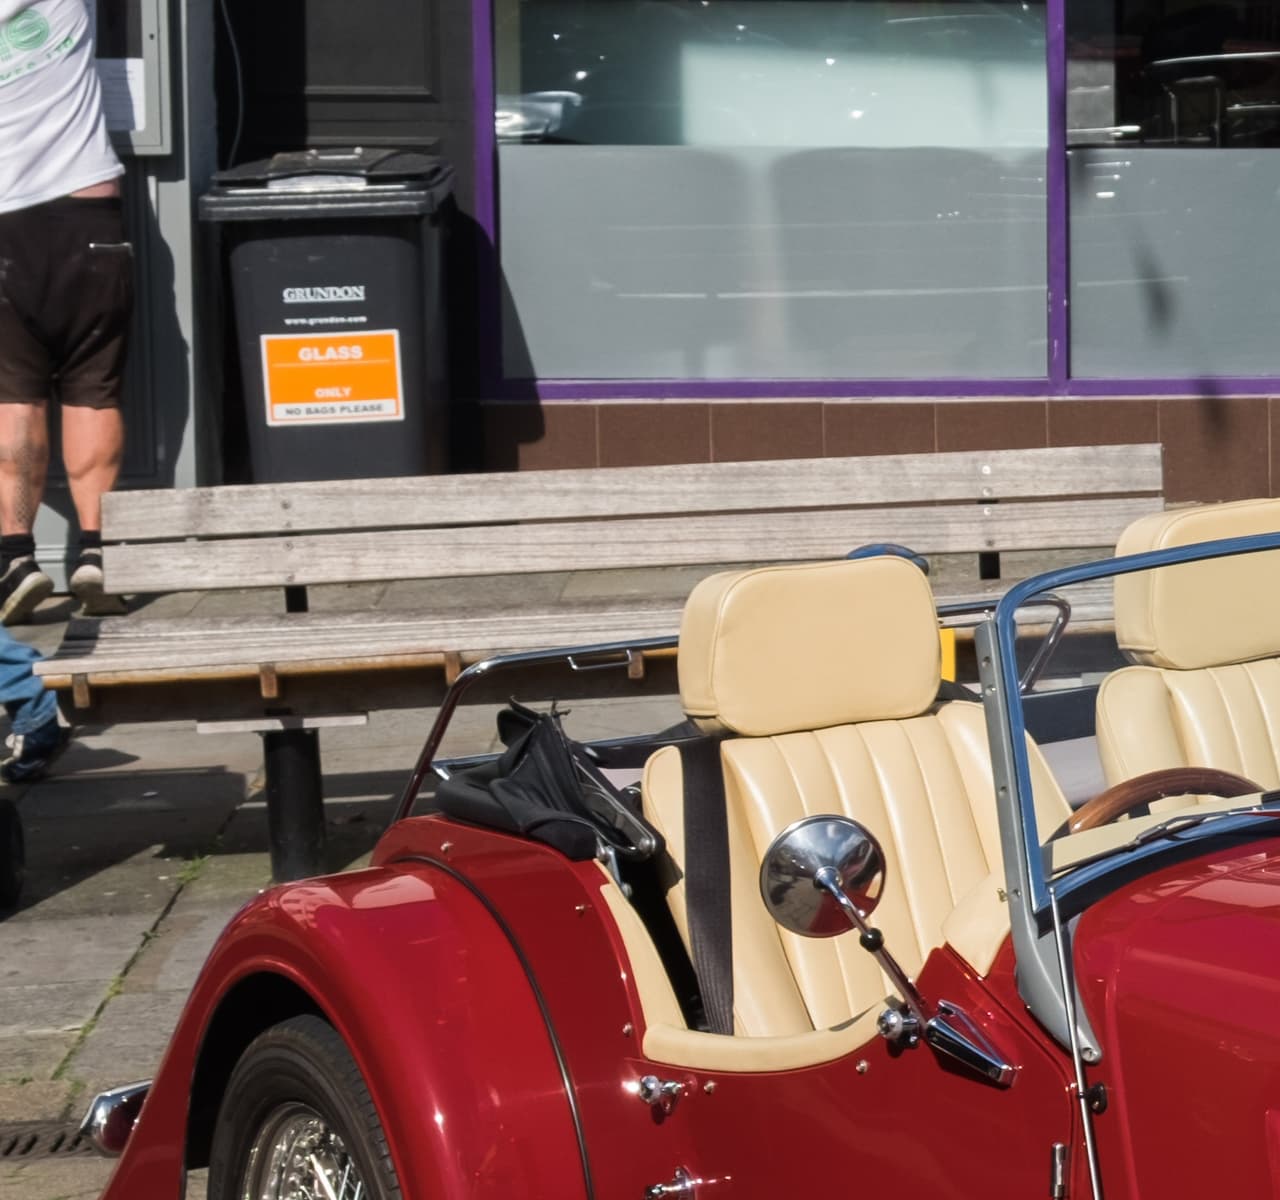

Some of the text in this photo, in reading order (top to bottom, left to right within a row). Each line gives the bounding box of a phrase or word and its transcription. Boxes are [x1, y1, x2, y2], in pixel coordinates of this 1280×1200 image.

[282, 285, 366, 303] GRUNDON
[284, 316, 368, 326] www.grundon.com
[298, 345, 364, 362] GLASS
[315, 386, 352, 398] ONLY
[286, 403, 384, 415] NO BAGS PLEASE
